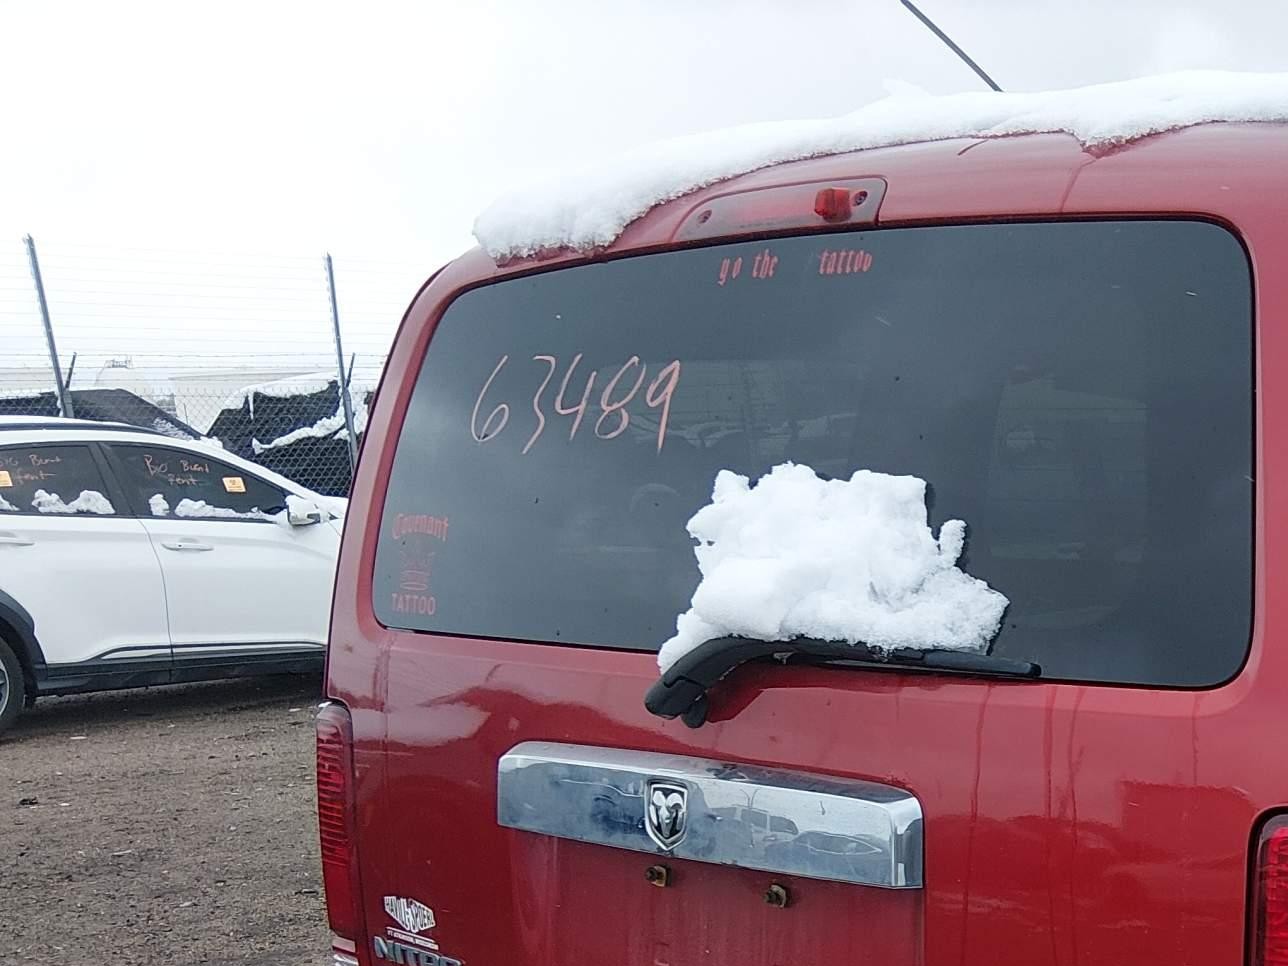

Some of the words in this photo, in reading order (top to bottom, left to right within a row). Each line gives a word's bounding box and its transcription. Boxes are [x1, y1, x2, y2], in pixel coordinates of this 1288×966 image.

[752, 248, 778, 279] the
[817, 249, 873, 275] tattoo
[471, 353, 680, 455] 63489
[391, 592, 437, 616] TATTOO
